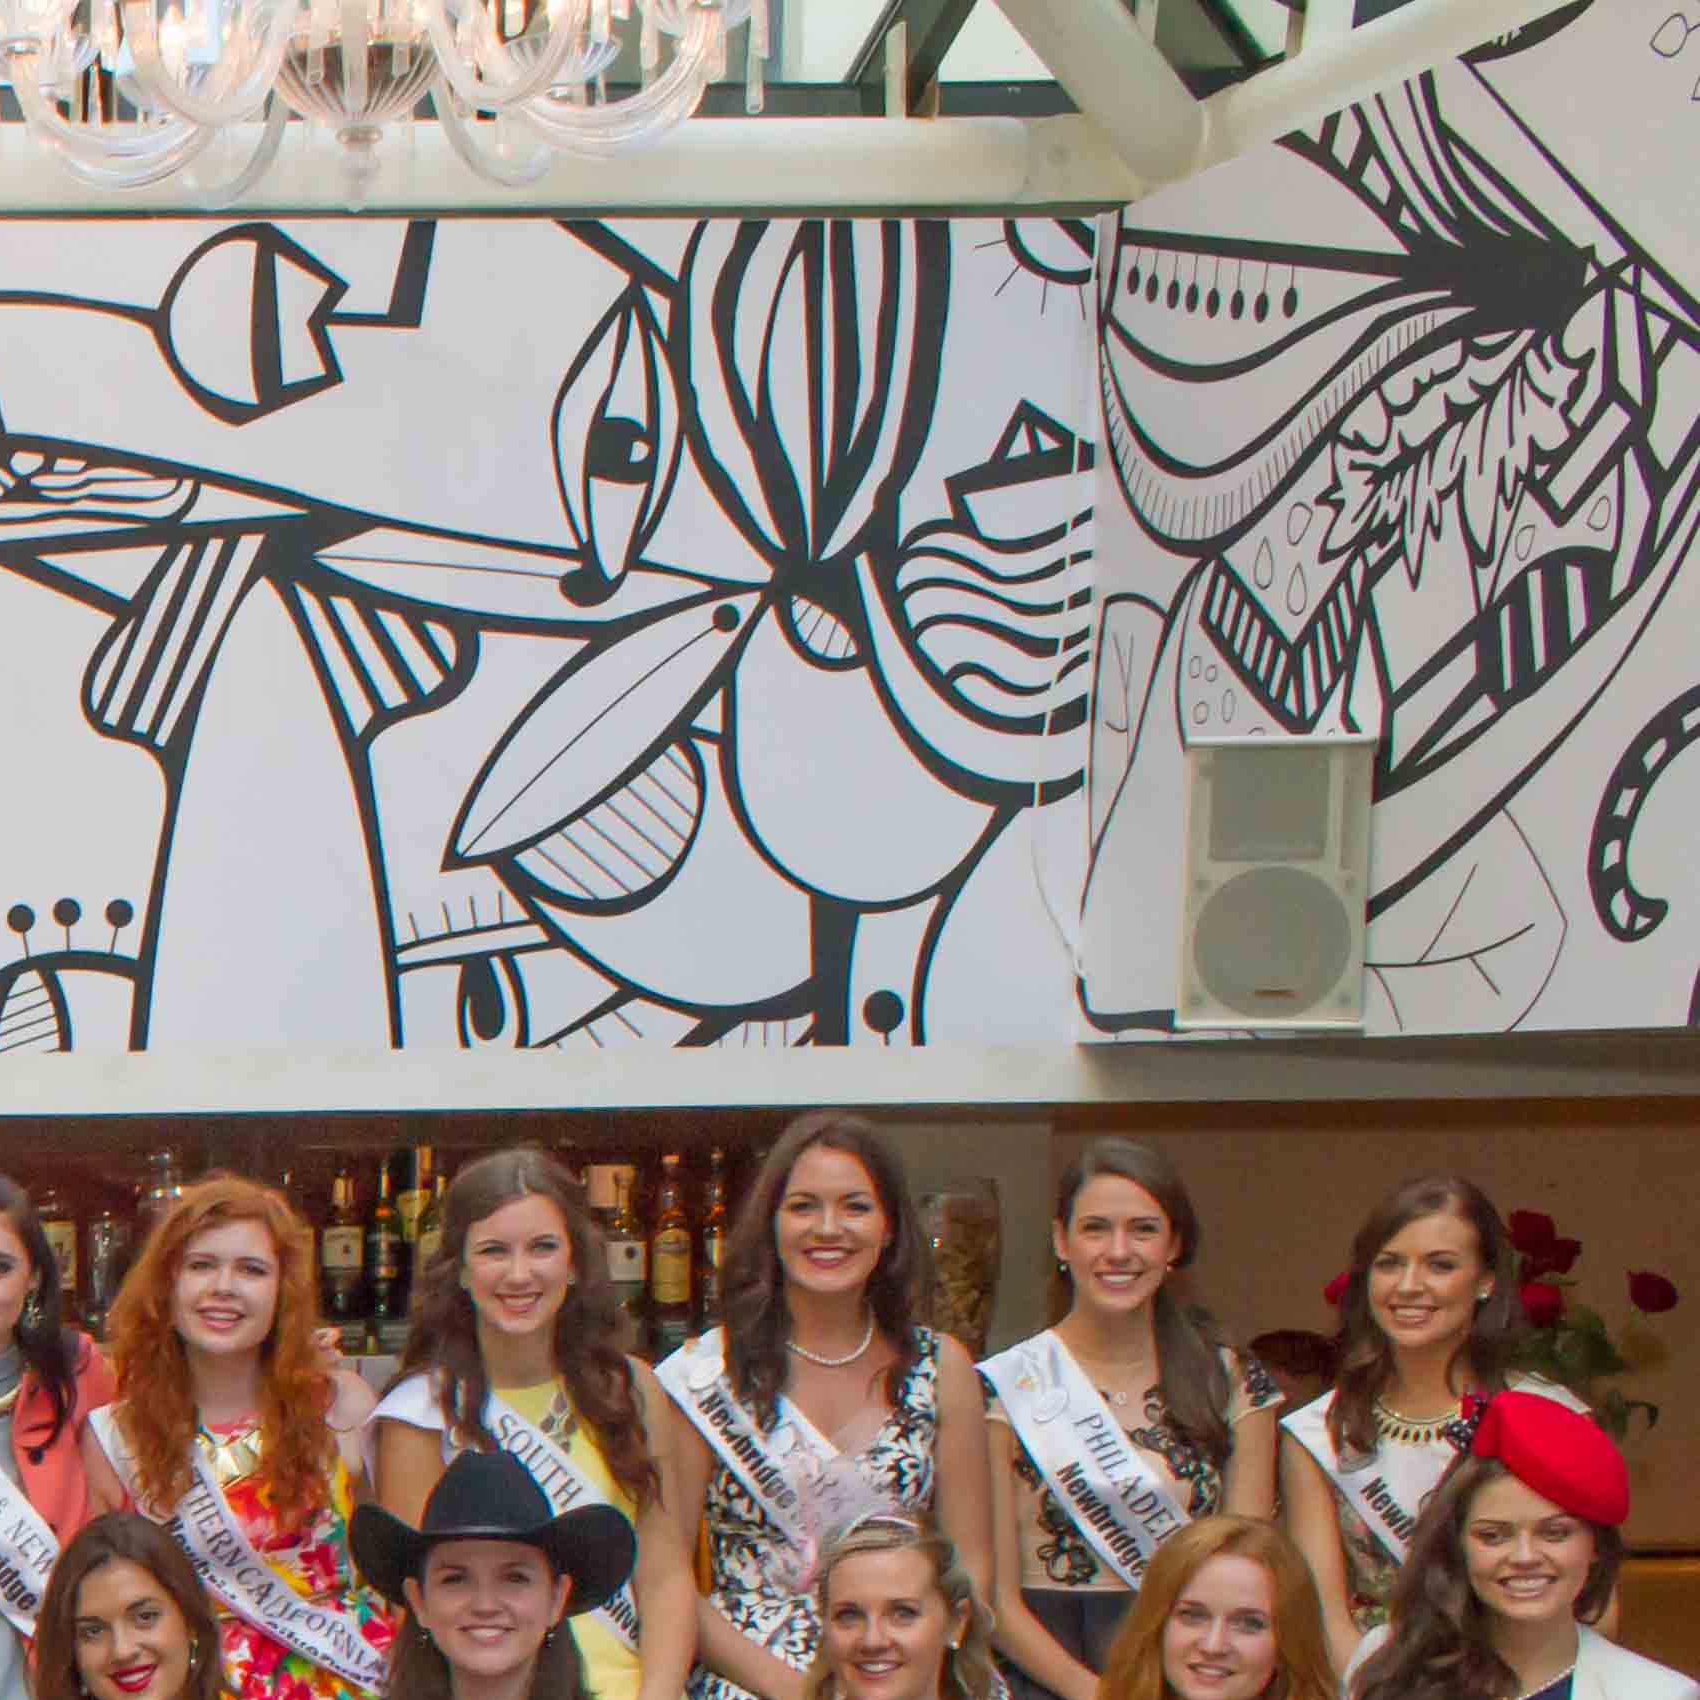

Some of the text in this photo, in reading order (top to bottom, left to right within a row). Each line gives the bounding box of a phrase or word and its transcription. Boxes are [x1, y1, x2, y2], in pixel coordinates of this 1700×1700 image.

[498, 1412, 583, 1507] SOUTH
[698, 1391, 797, 1511] Newbridge
[4, 1517, 60, 1578] NEW
